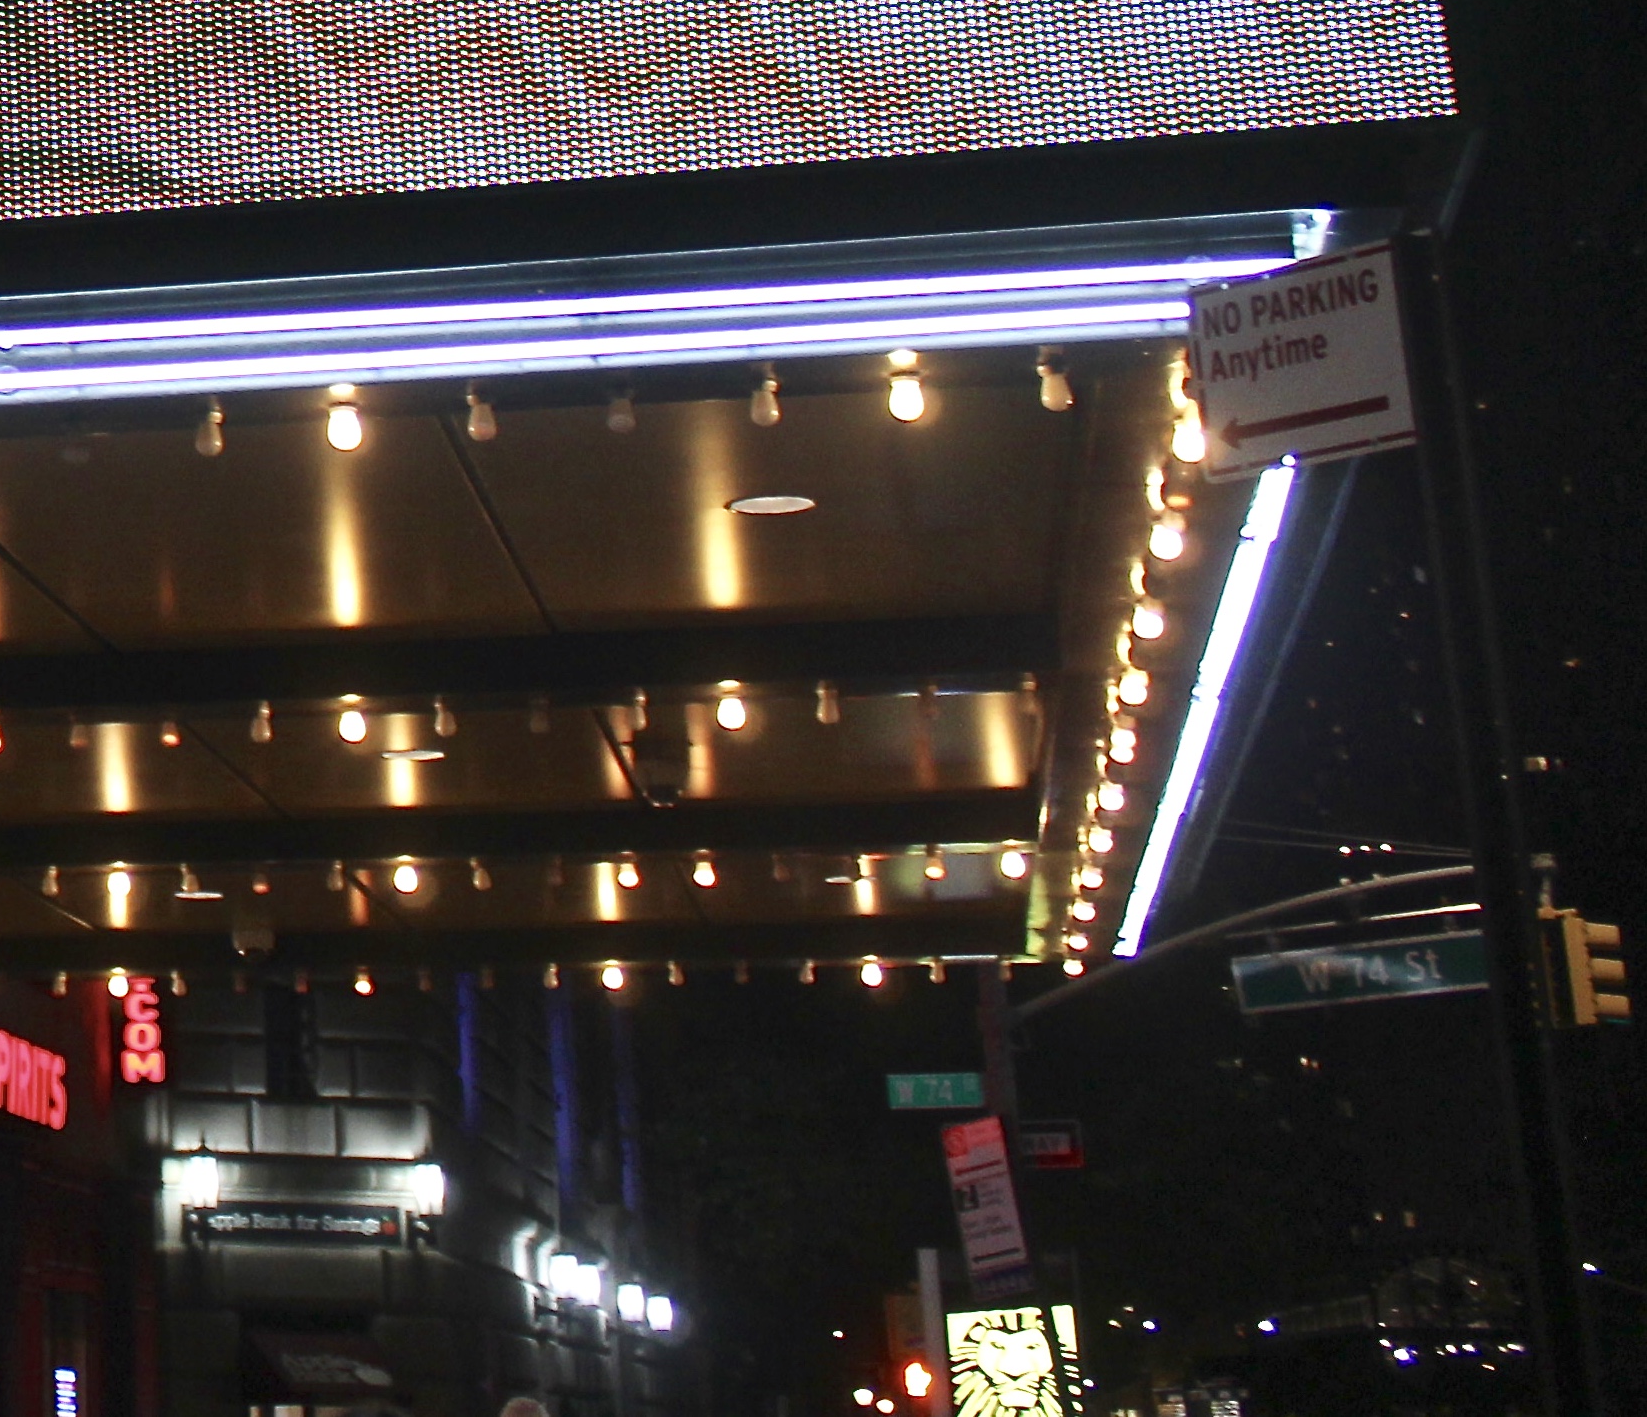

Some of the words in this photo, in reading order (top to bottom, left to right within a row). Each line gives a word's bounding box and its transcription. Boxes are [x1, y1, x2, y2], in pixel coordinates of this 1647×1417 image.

[1203, 300, 1241, 339] NO
[1251, 268, 1379, 328] PARKING
[1209, 329, 1328, 384] Anytime
[1296, 960, 1331, 993] W
[1353, 954, 1390, 987] 74
[1406, 948, 1443, 982] St
